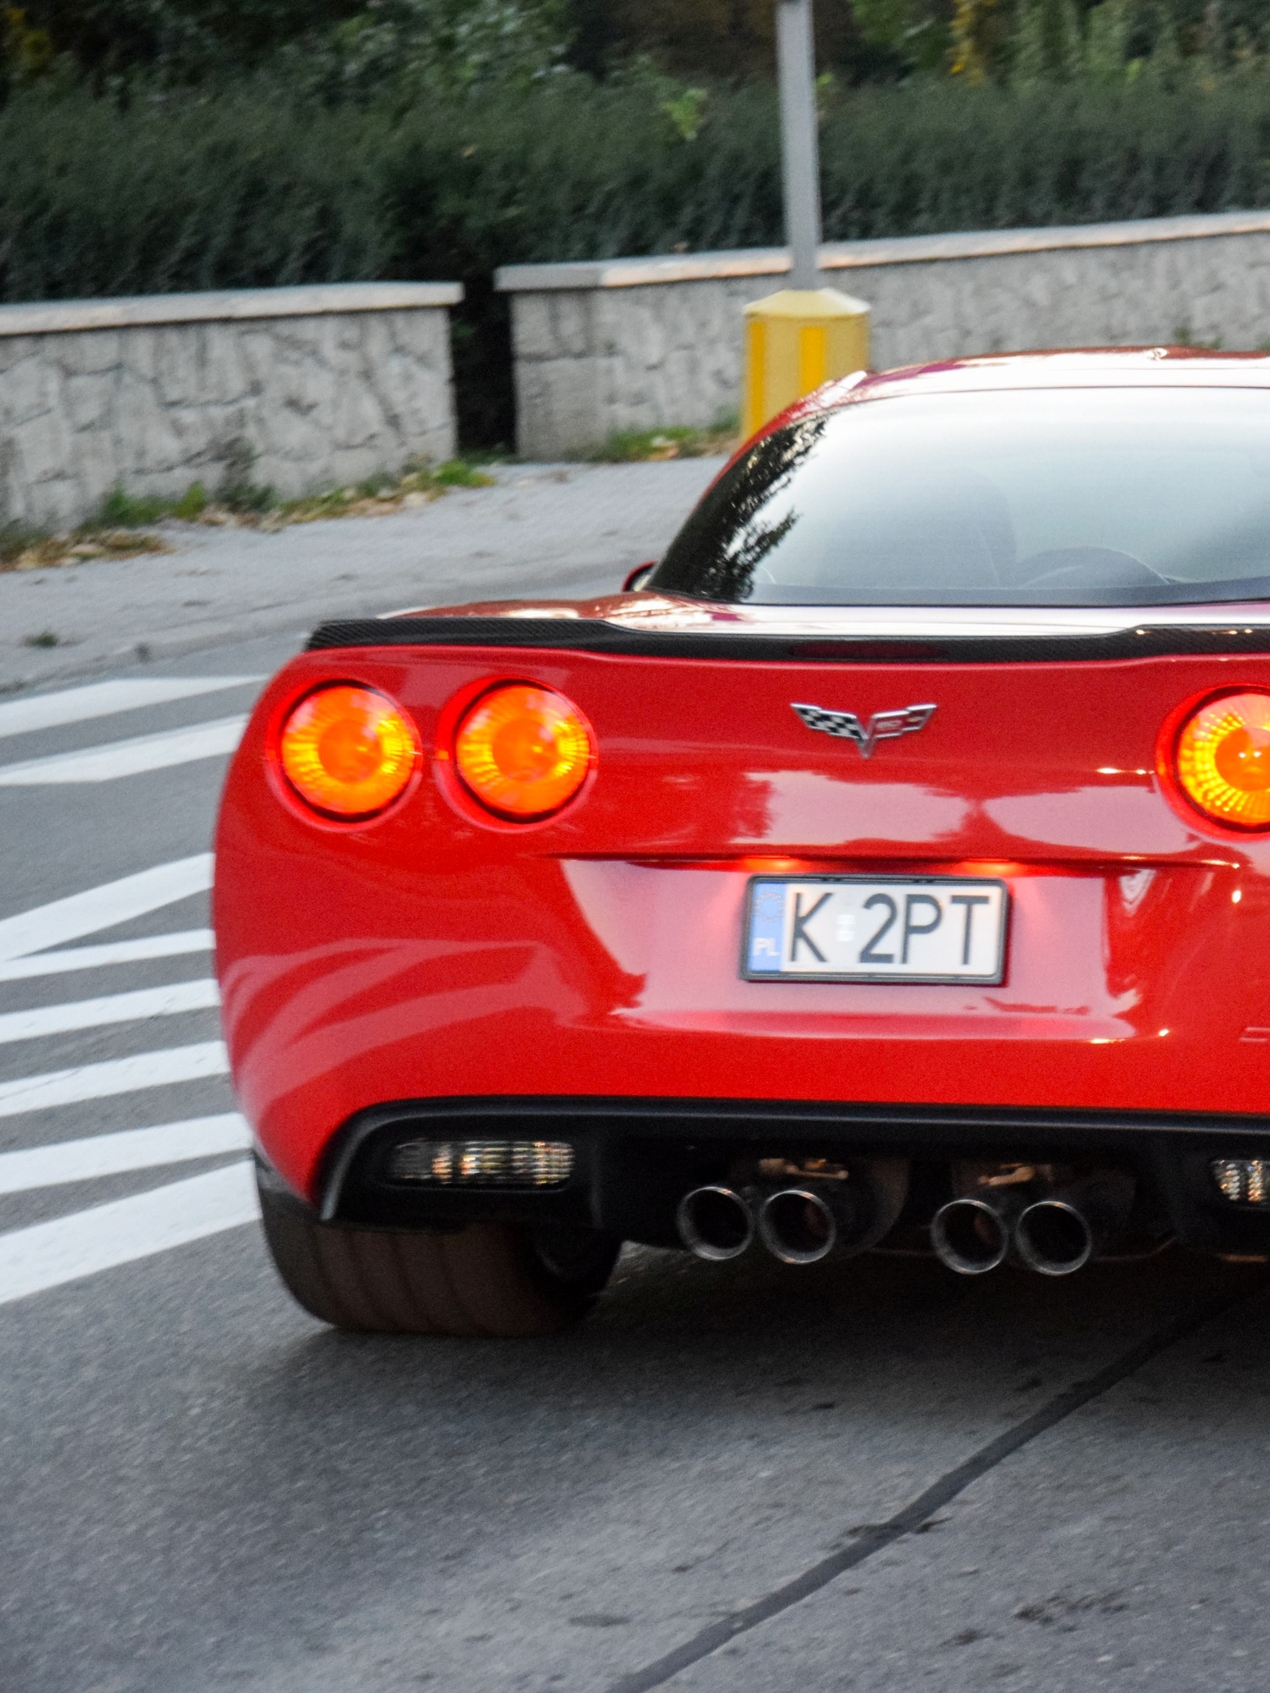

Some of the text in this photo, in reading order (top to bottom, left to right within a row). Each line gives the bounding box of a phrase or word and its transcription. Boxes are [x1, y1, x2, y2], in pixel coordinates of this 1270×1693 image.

[753, 938, 779, 956] PL
[789, 893, 990, 965] K 2PT
